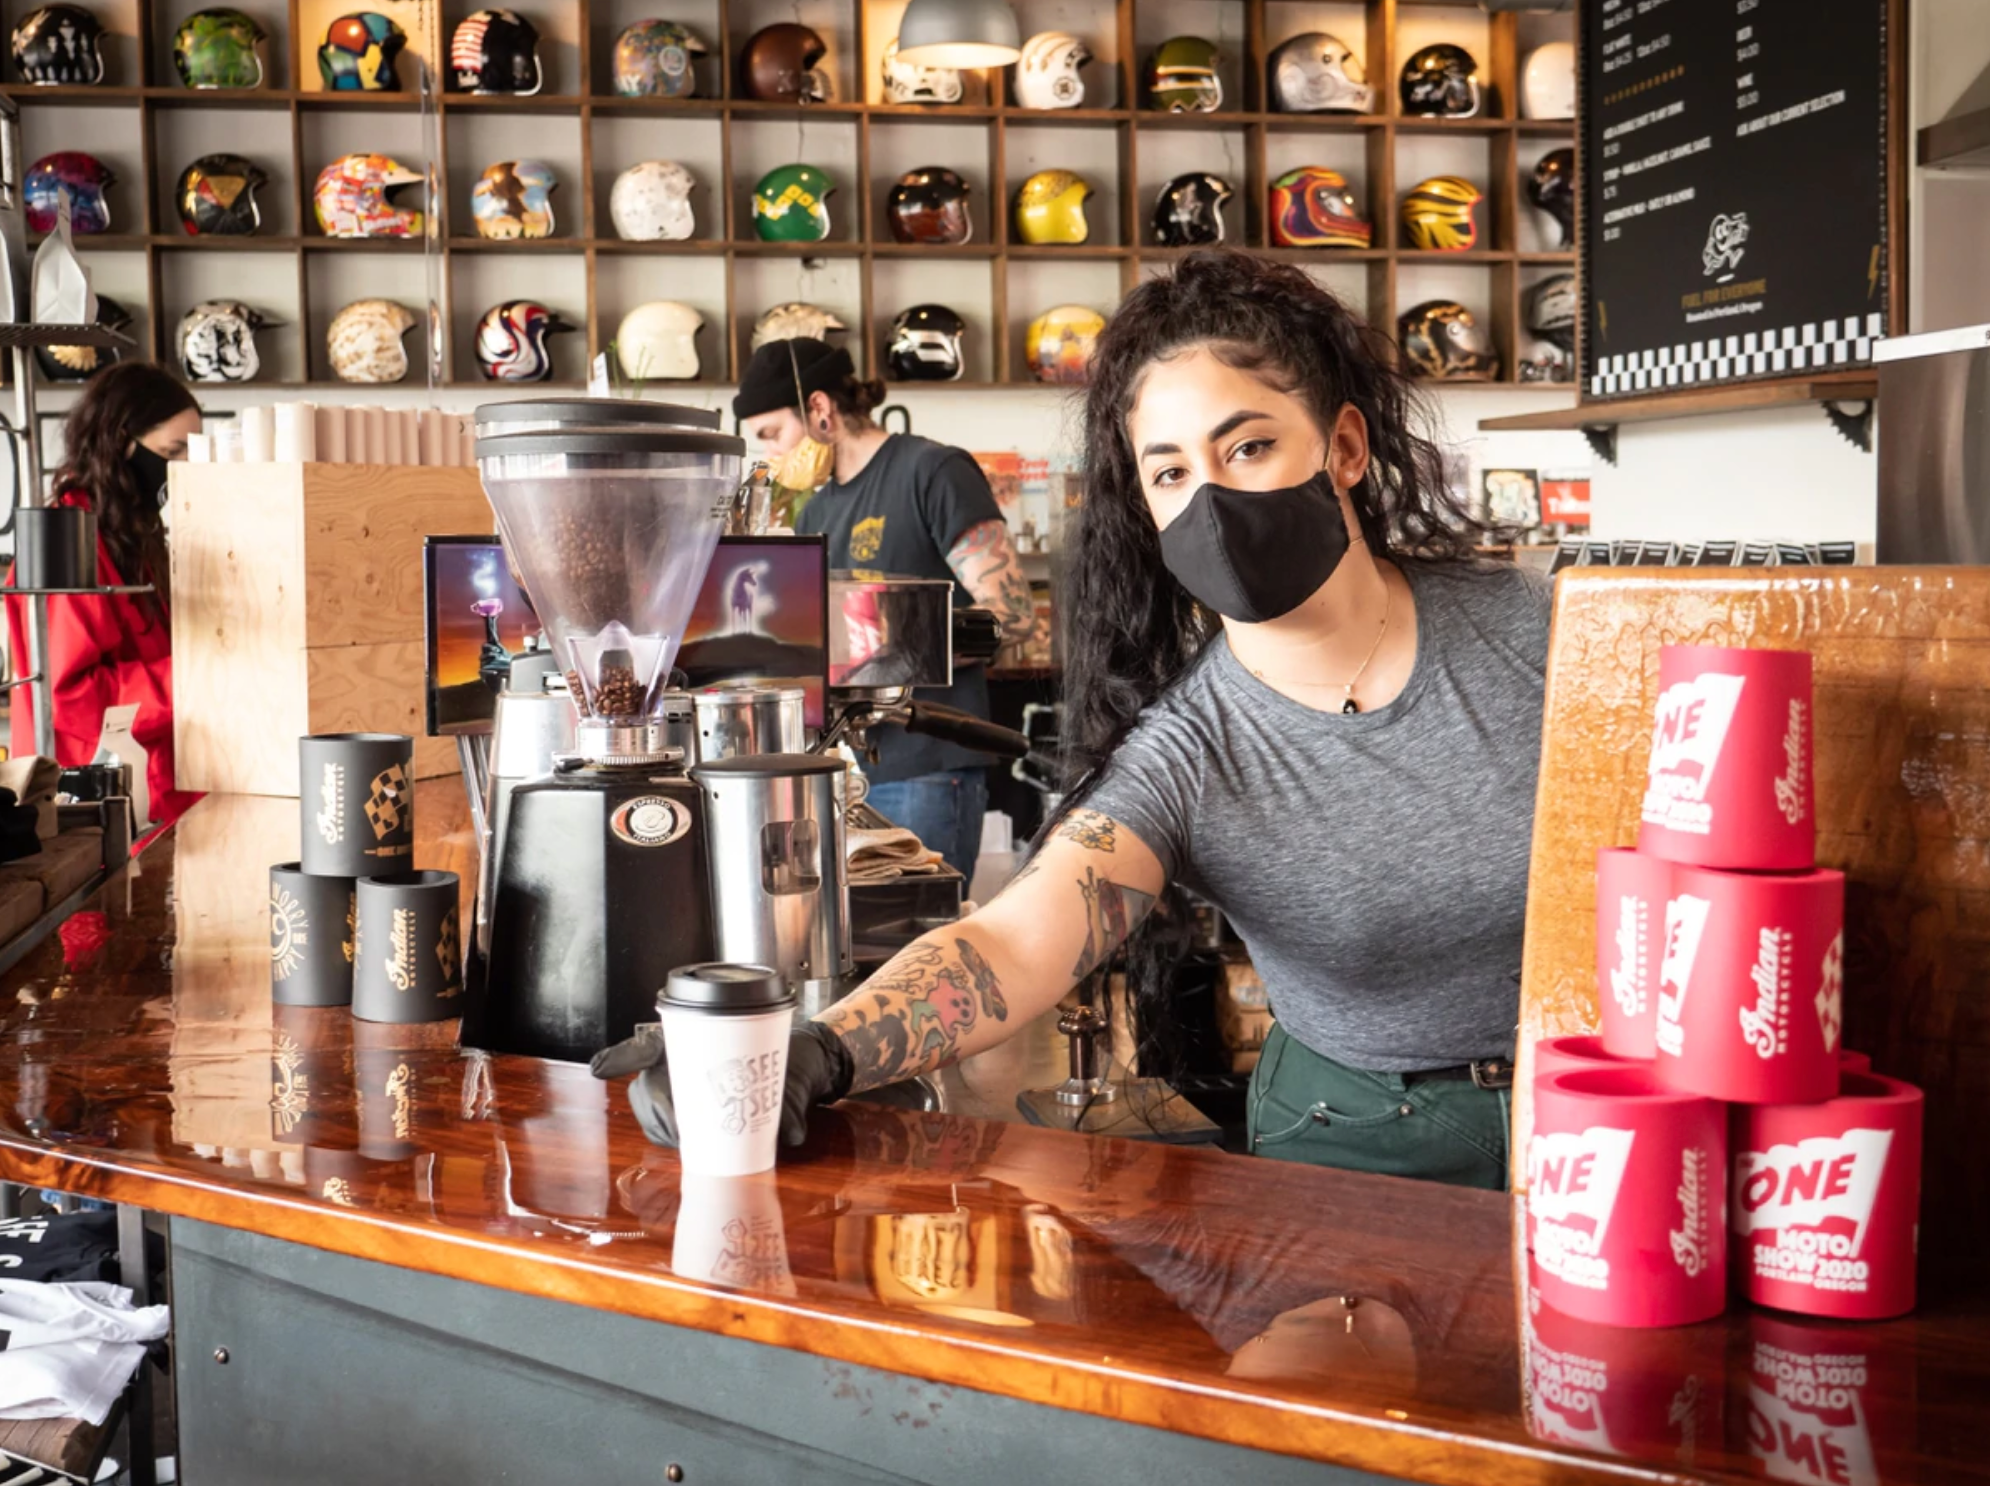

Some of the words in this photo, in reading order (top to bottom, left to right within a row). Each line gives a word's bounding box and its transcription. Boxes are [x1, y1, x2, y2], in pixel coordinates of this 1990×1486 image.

[1681, 292, 1702, 309] FUEL
[1703, 288, 1719, 304] FOR
[1720, 278, 1766, 301] EVERYONE
[1655, 698, 1706, 750] NE
[1774, 698, 1800, 824] Indian
[317, 763, 337, 844] Indian
[385, 908, 410, 990] Indian
[408, 911, 416, 987] MOTORCYCLE
[1610, 895, 1638, 1018] Indian
[1636, 901, 1648, 1013] MOTORCYCLE
[1739, 926, 1781, 1059] Indian
[1777, 932, 1792, 1054] MOTORCYCLE
[747, 1050, 779, 1084] SEE
[749, 1080, 779, 1118] SEE
[1670, 1147, 1700, 1278] Indian
[1741, 1153, 1857, 1213] ONE
[1754, 1244, 1817, 1273] SHOW
[1815, 1258, 1868, 1281] 2020
[1755, 1265, 1815, 1285] PORTLAND
[1813, 1278, 1868, 1293] OREGON
[1777, 1227, 1851, 1258] MOTO
